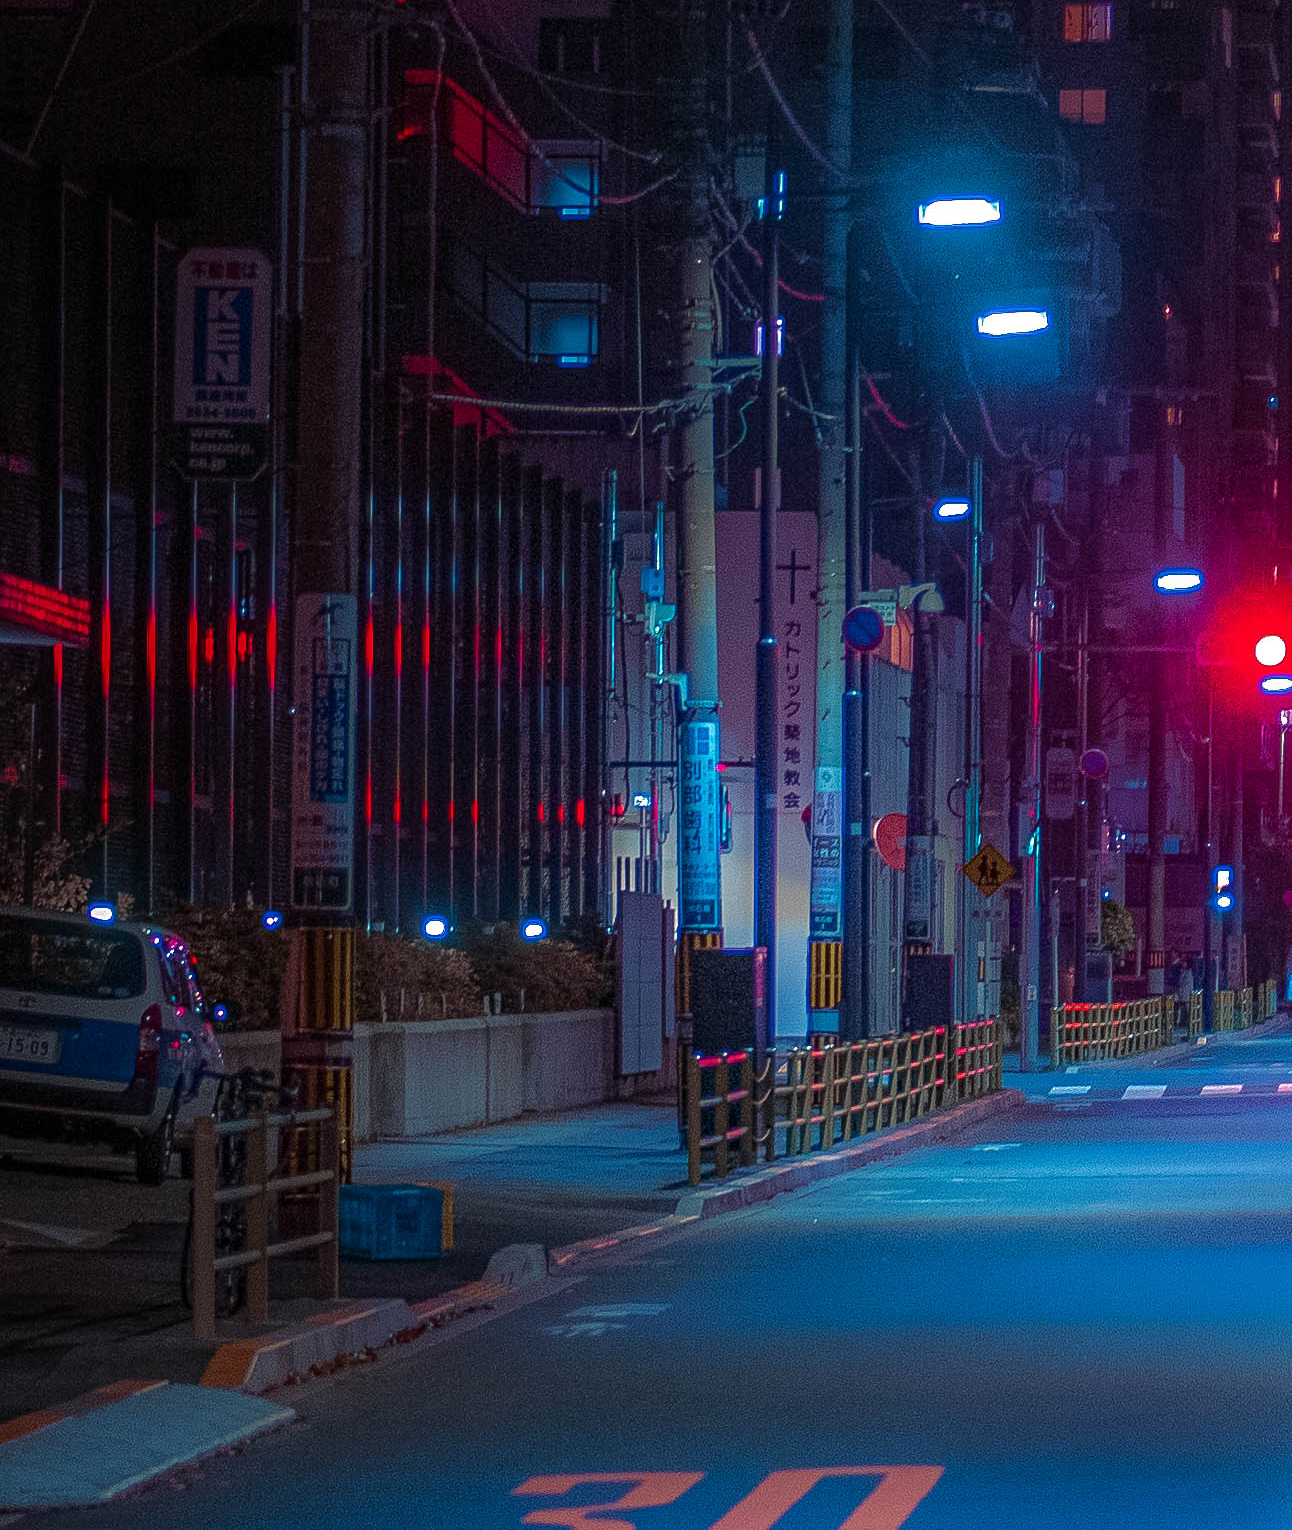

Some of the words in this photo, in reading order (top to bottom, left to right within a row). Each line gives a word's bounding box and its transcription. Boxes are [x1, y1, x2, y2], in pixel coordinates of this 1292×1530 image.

[206, 289, 241, 384] KEN
[783, 620, 801, 809] カトリック築地教会
